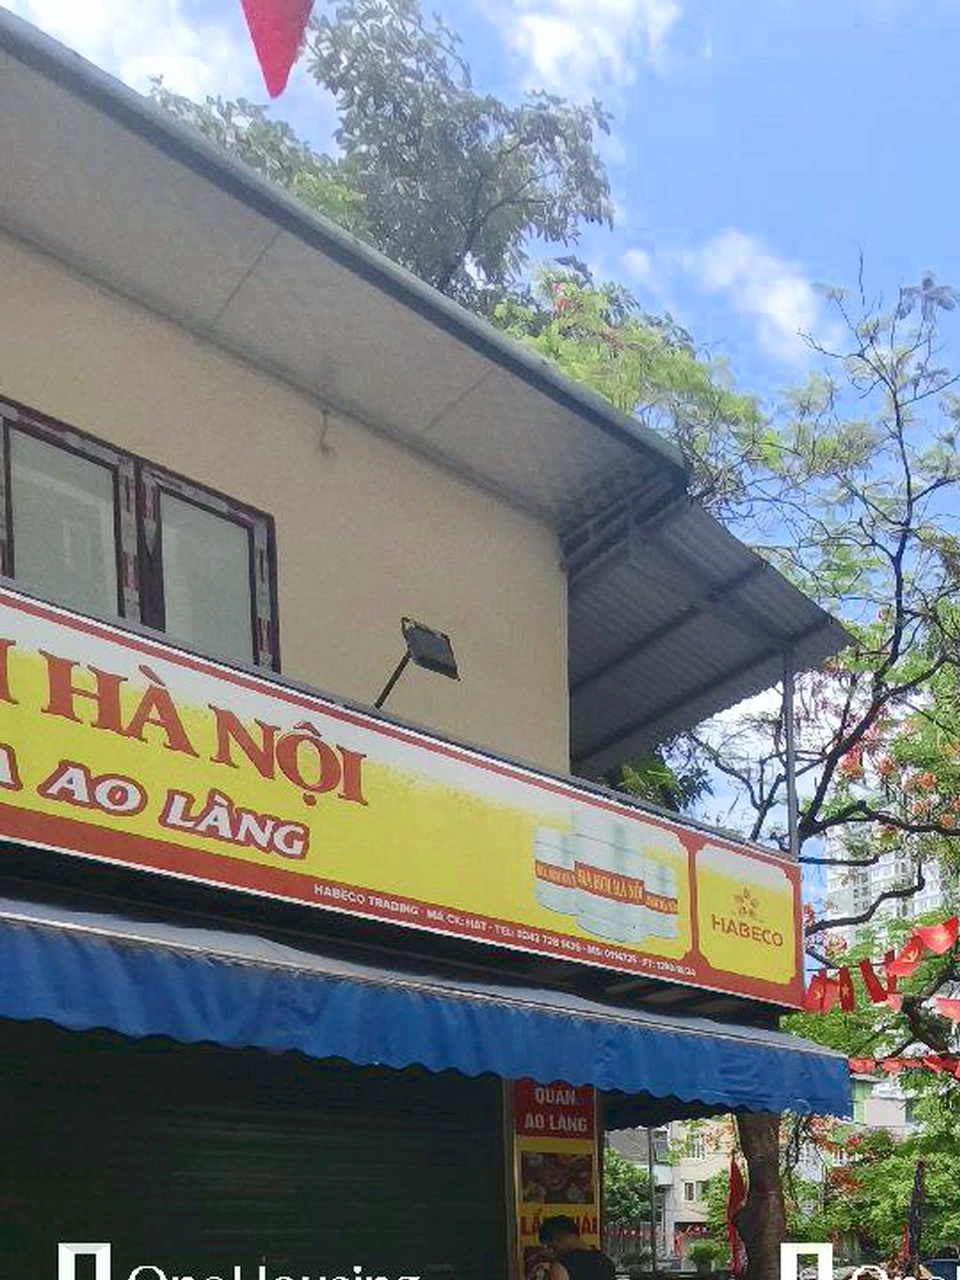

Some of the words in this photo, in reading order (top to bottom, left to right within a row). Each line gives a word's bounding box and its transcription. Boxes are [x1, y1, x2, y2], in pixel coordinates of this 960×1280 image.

[39, 649, 200, 758] HÀ
[208, 702, 369, 806] NỘI
[40, 761, 147, 815] AO
[160, 790, 309, 859] LÀNG
[313, 883, 366, 905] HABECO
[367, 895, 419, 916] TRADING
[711, 913, 784, 948] HABECO
